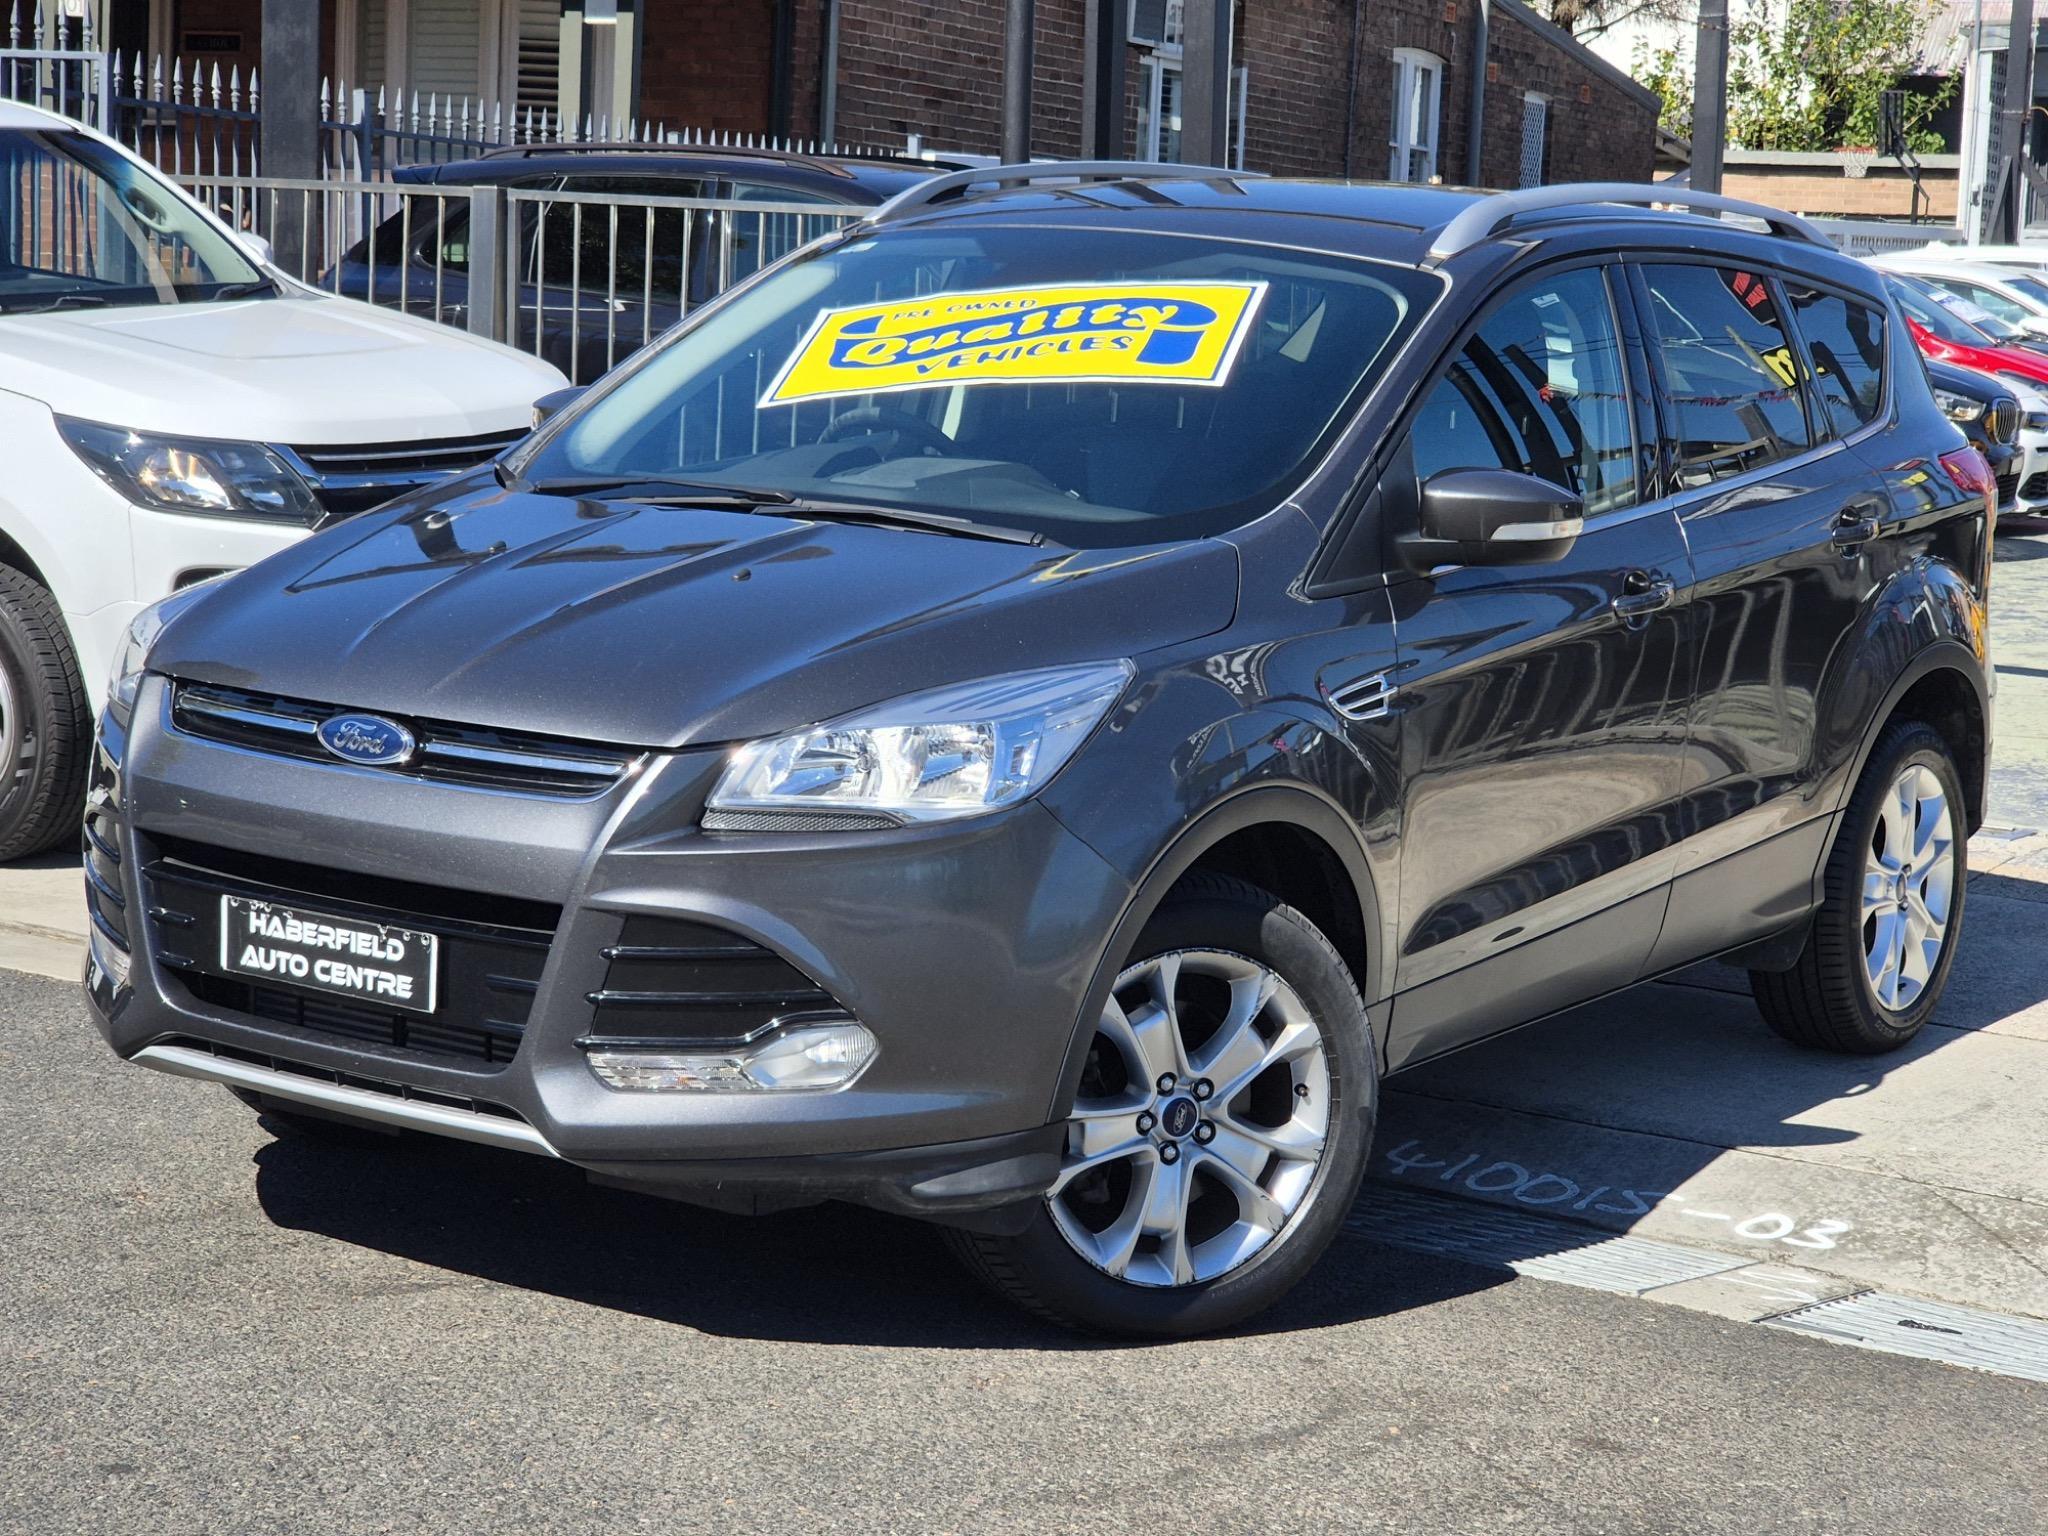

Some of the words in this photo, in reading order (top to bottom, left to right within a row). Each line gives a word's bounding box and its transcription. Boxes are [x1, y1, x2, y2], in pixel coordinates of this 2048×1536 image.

[893, 309, 934, 321] PRE
[946, 299, 1037, 314] OWNED
[841, 303, 1180, 367] Quality
[916, 335, 1134, 375] VEHICLES
[333, 721, 388, 755] Ford
[249, 910, 405, 962] HABERFIELD
[239, 944, 310, 978] AUTO
[313, 958, 414, 1000] CENTRE
